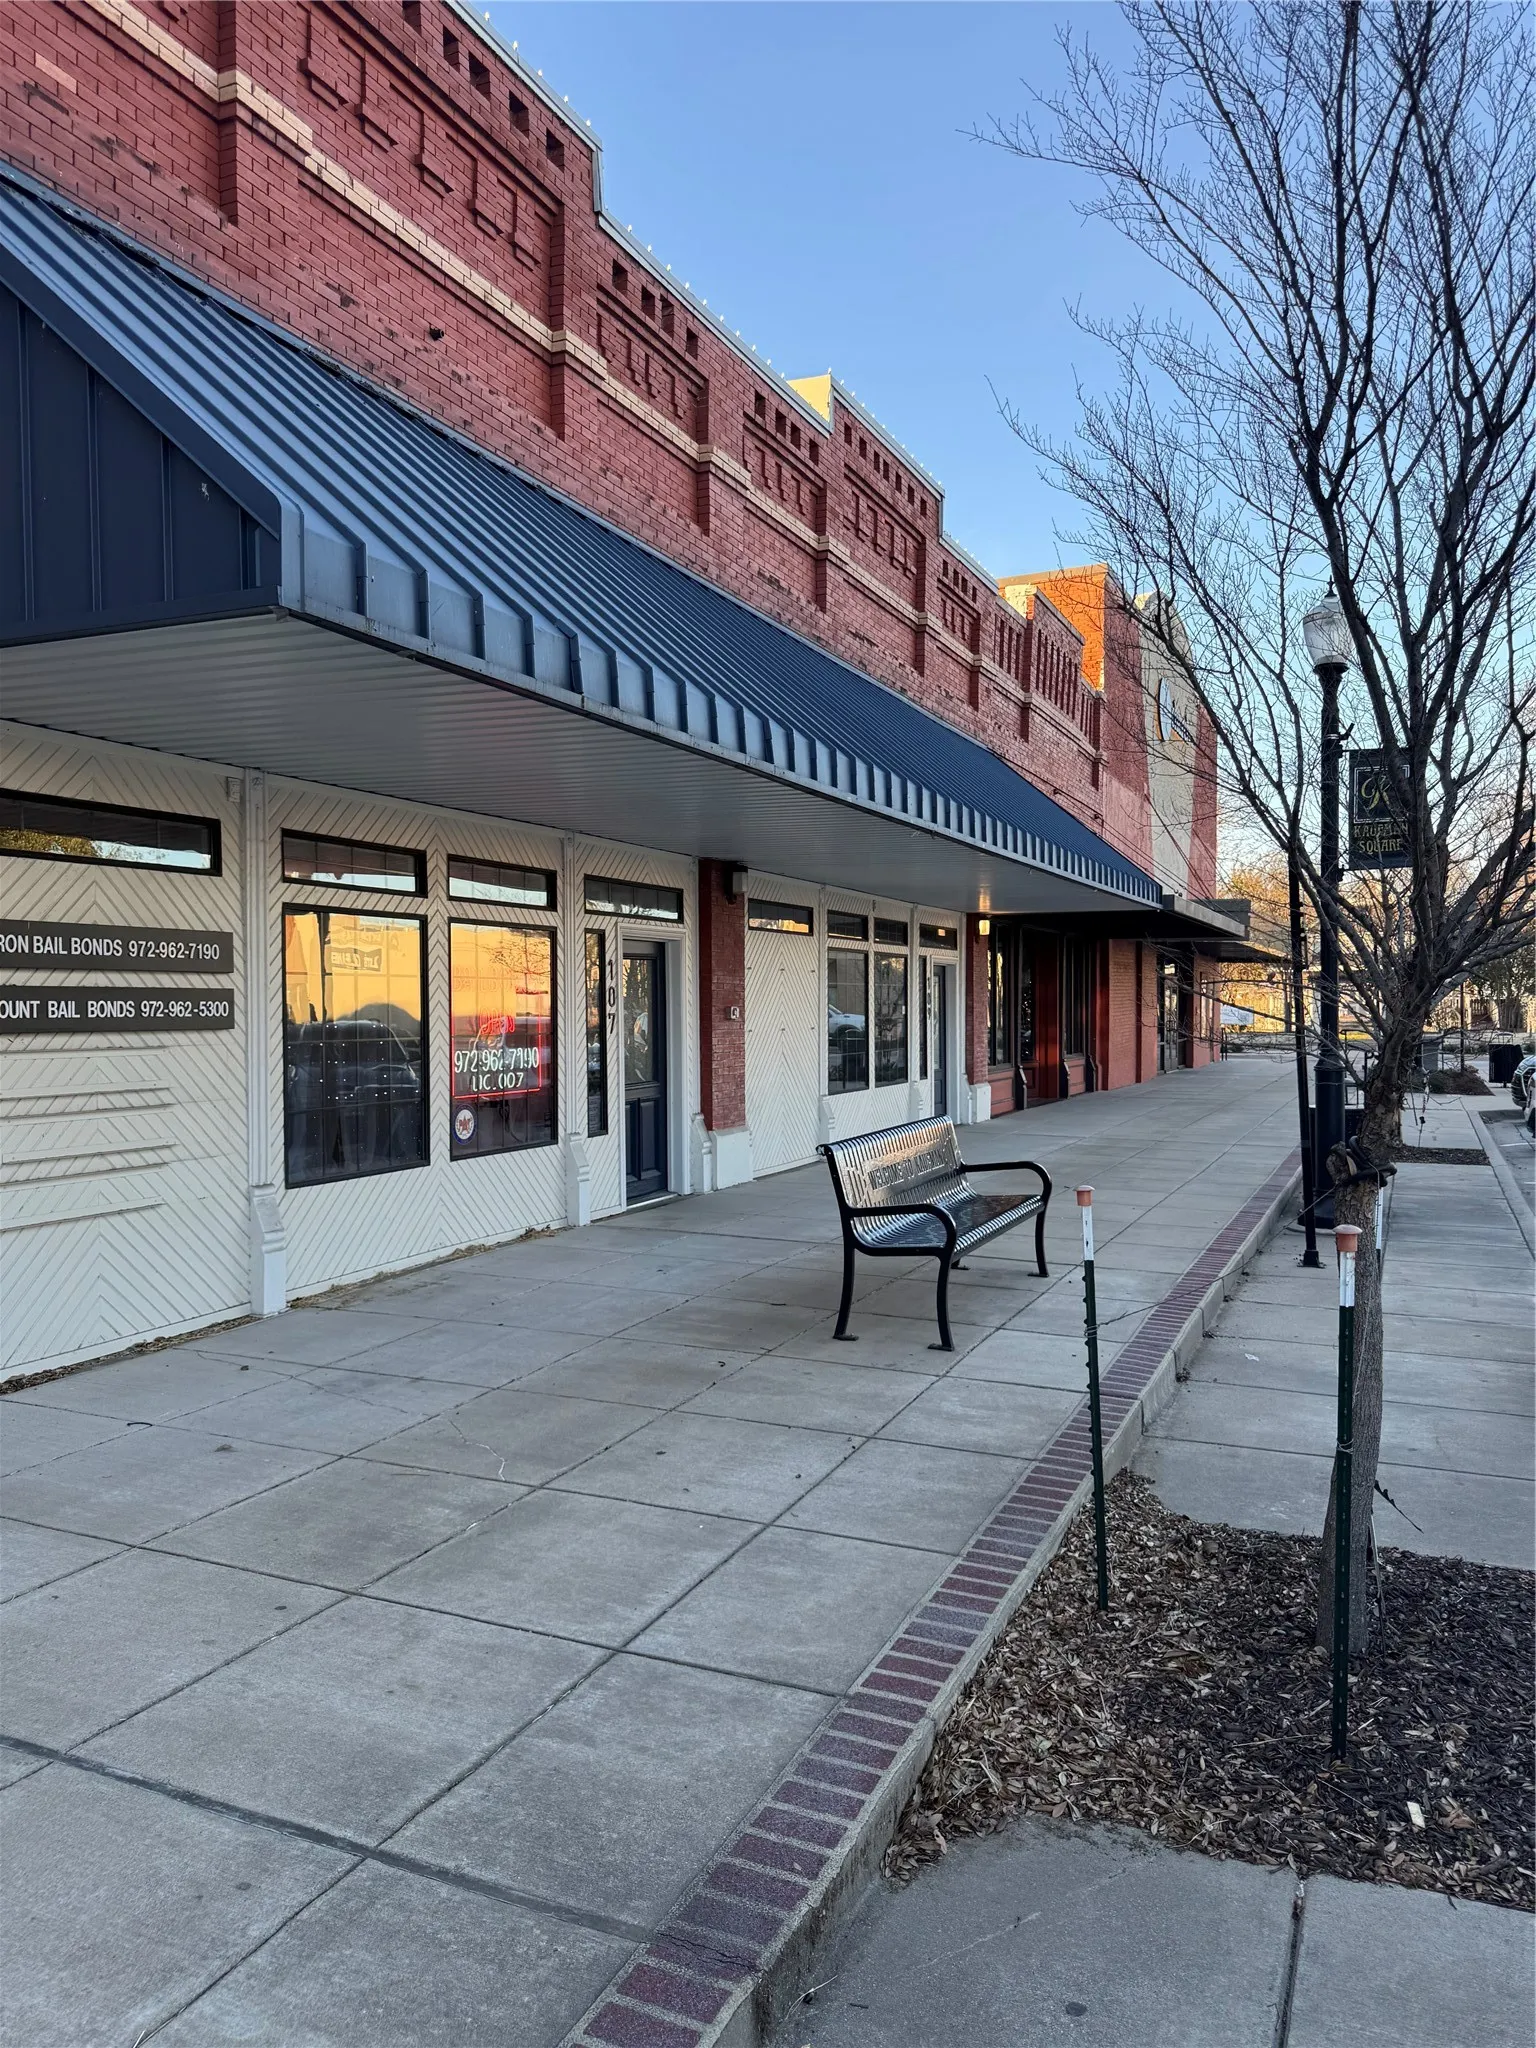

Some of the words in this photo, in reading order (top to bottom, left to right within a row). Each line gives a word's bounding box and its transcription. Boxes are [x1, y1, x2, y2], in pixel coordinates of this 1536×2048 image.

[1354, 823, 1408, 837] KAUFMAN
[33, 935, 67, 955] BAIL
[71, 937, 122, 957] BONDS
[129, 940, 220, 960] 972-962-7190
[48, 1001, 80, 1018] BAIL
[88, 1001, 135, 1018] BONDS
[141, 1001, 229, 1017] 972-962-5300
[608, 959, 616, 1035] 107
[867, 1161, 905, 1191] WELCOME
[902, 1159, 915, 1179] TO
